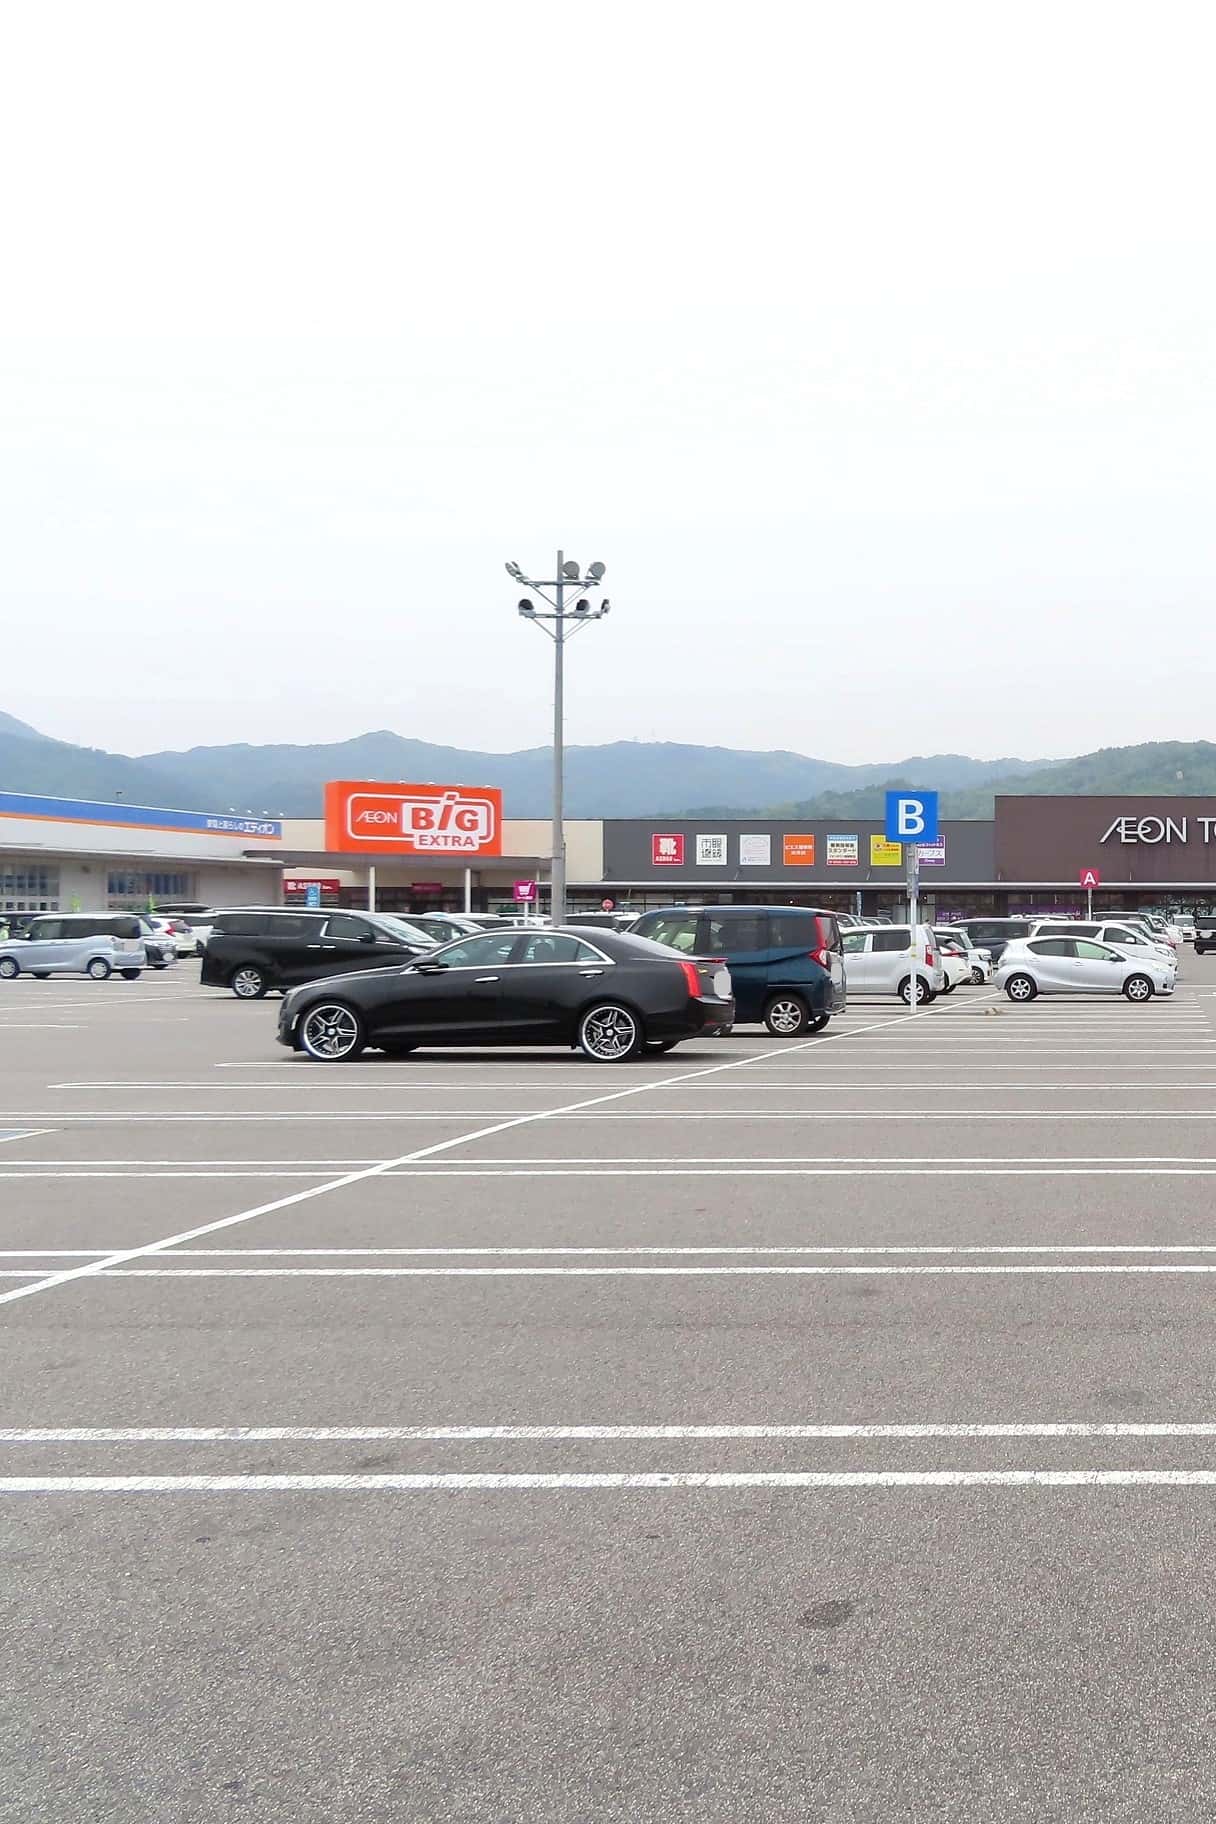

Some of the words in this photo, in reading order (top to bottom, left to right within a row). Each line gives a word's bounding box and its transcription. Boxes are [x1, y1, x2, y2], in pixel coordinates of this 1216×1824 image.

[897, 799, 925, 836] B
[418, 834, 476, 848] EXTRA
[1084, 872, 1097, 885] A
